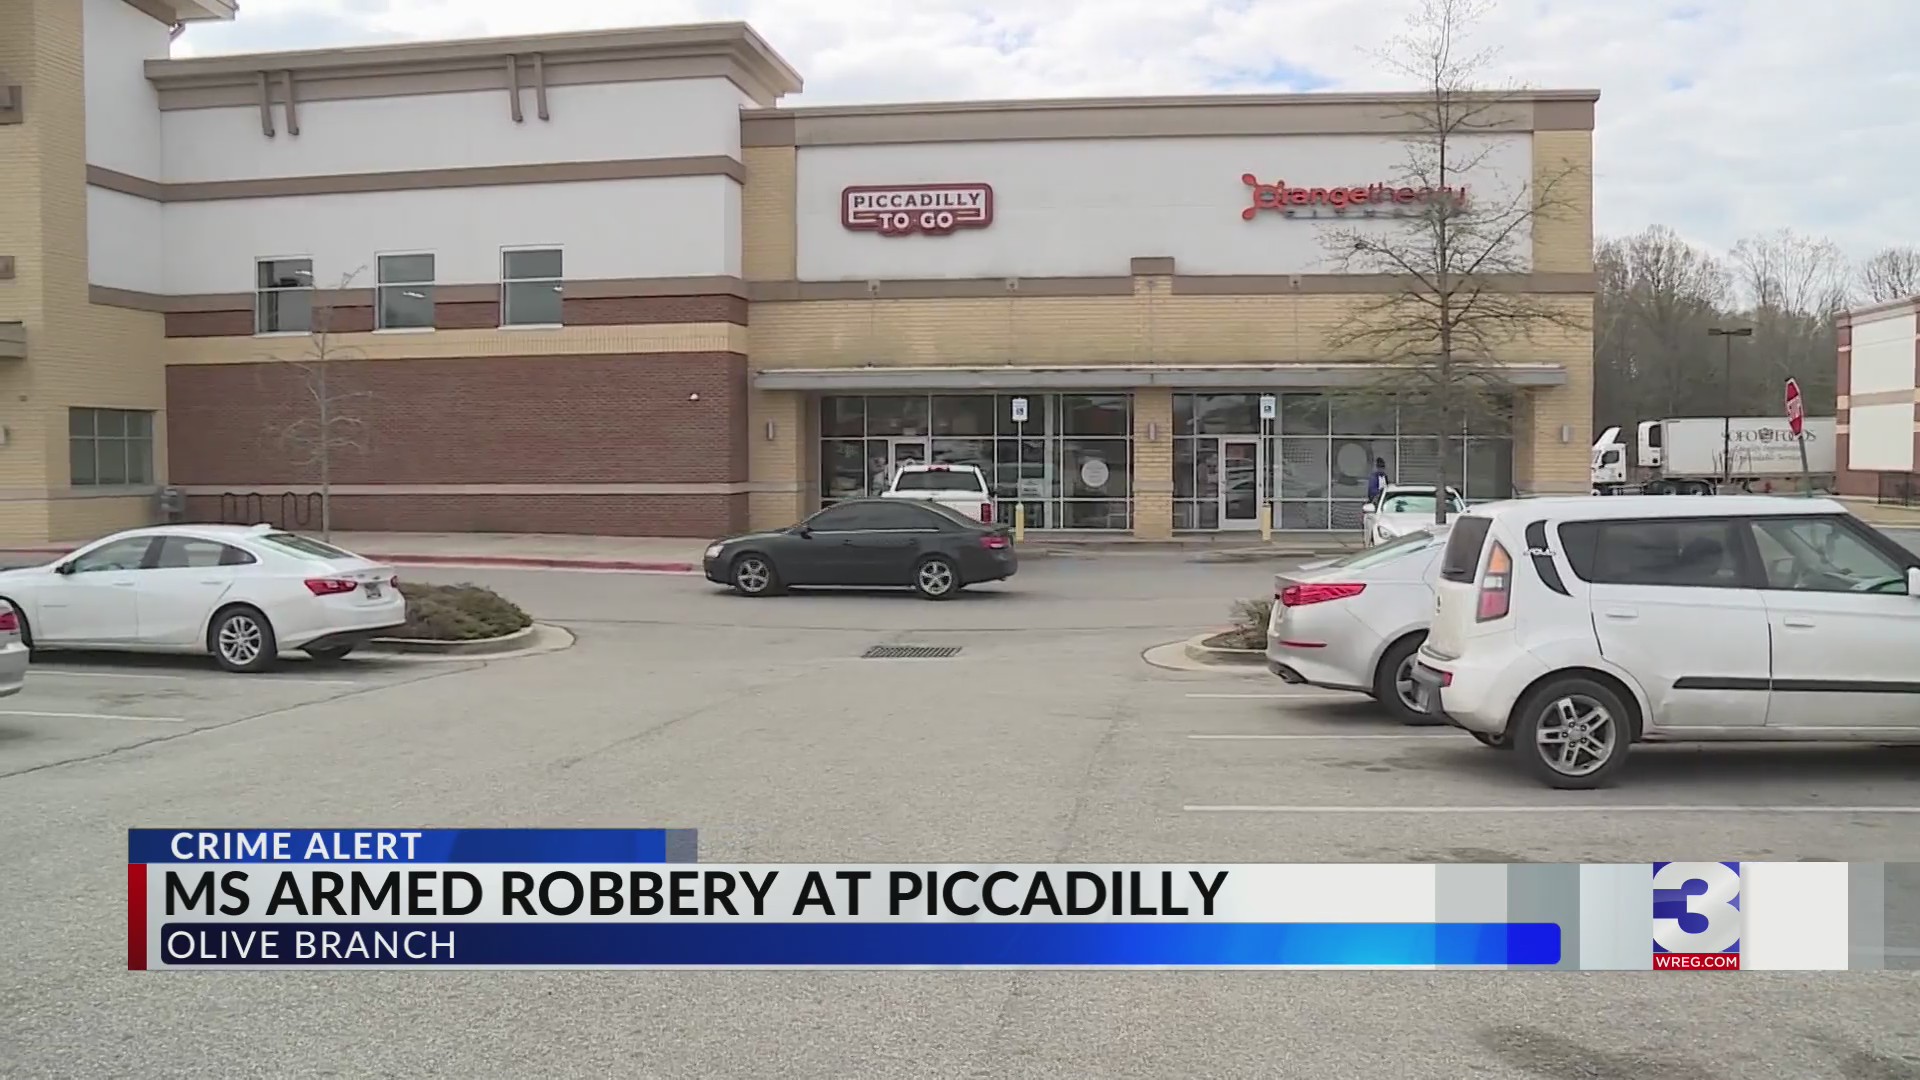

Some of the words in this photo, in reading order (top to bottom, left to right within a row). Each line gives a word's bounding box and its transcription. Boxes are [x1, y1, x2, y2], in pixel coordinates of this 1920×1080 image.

[853, 192, 980, 208] PICCADILLY
[879, 212, 910, 229] TO
[920, 211, 954, 228] GO
